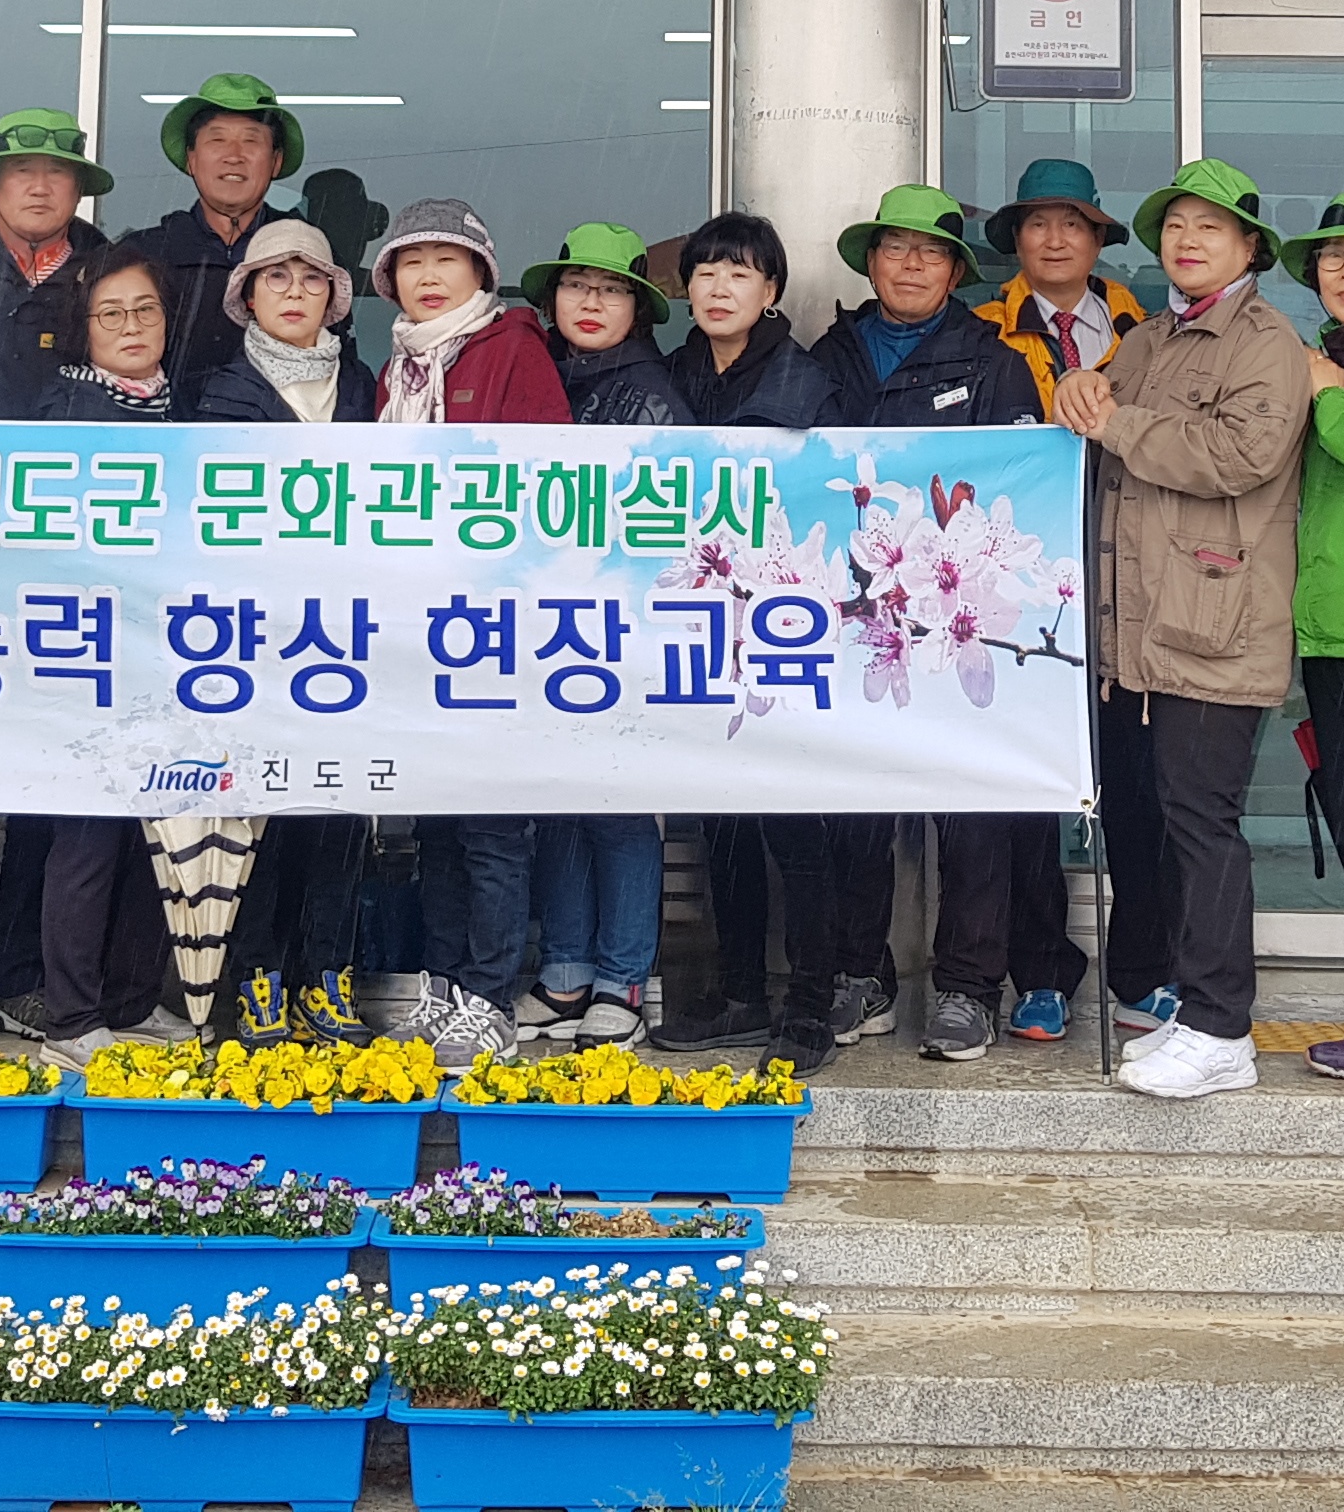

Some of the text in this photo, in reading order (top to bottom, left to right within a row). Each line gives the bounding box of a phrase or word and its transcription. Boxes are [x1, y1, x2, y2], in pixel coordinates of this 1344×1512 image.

[197, 459, 775, 550] 문화관광해설사
[166, 594, 378, 714] 향상
[426, 594, 835, 714] 현장교육
